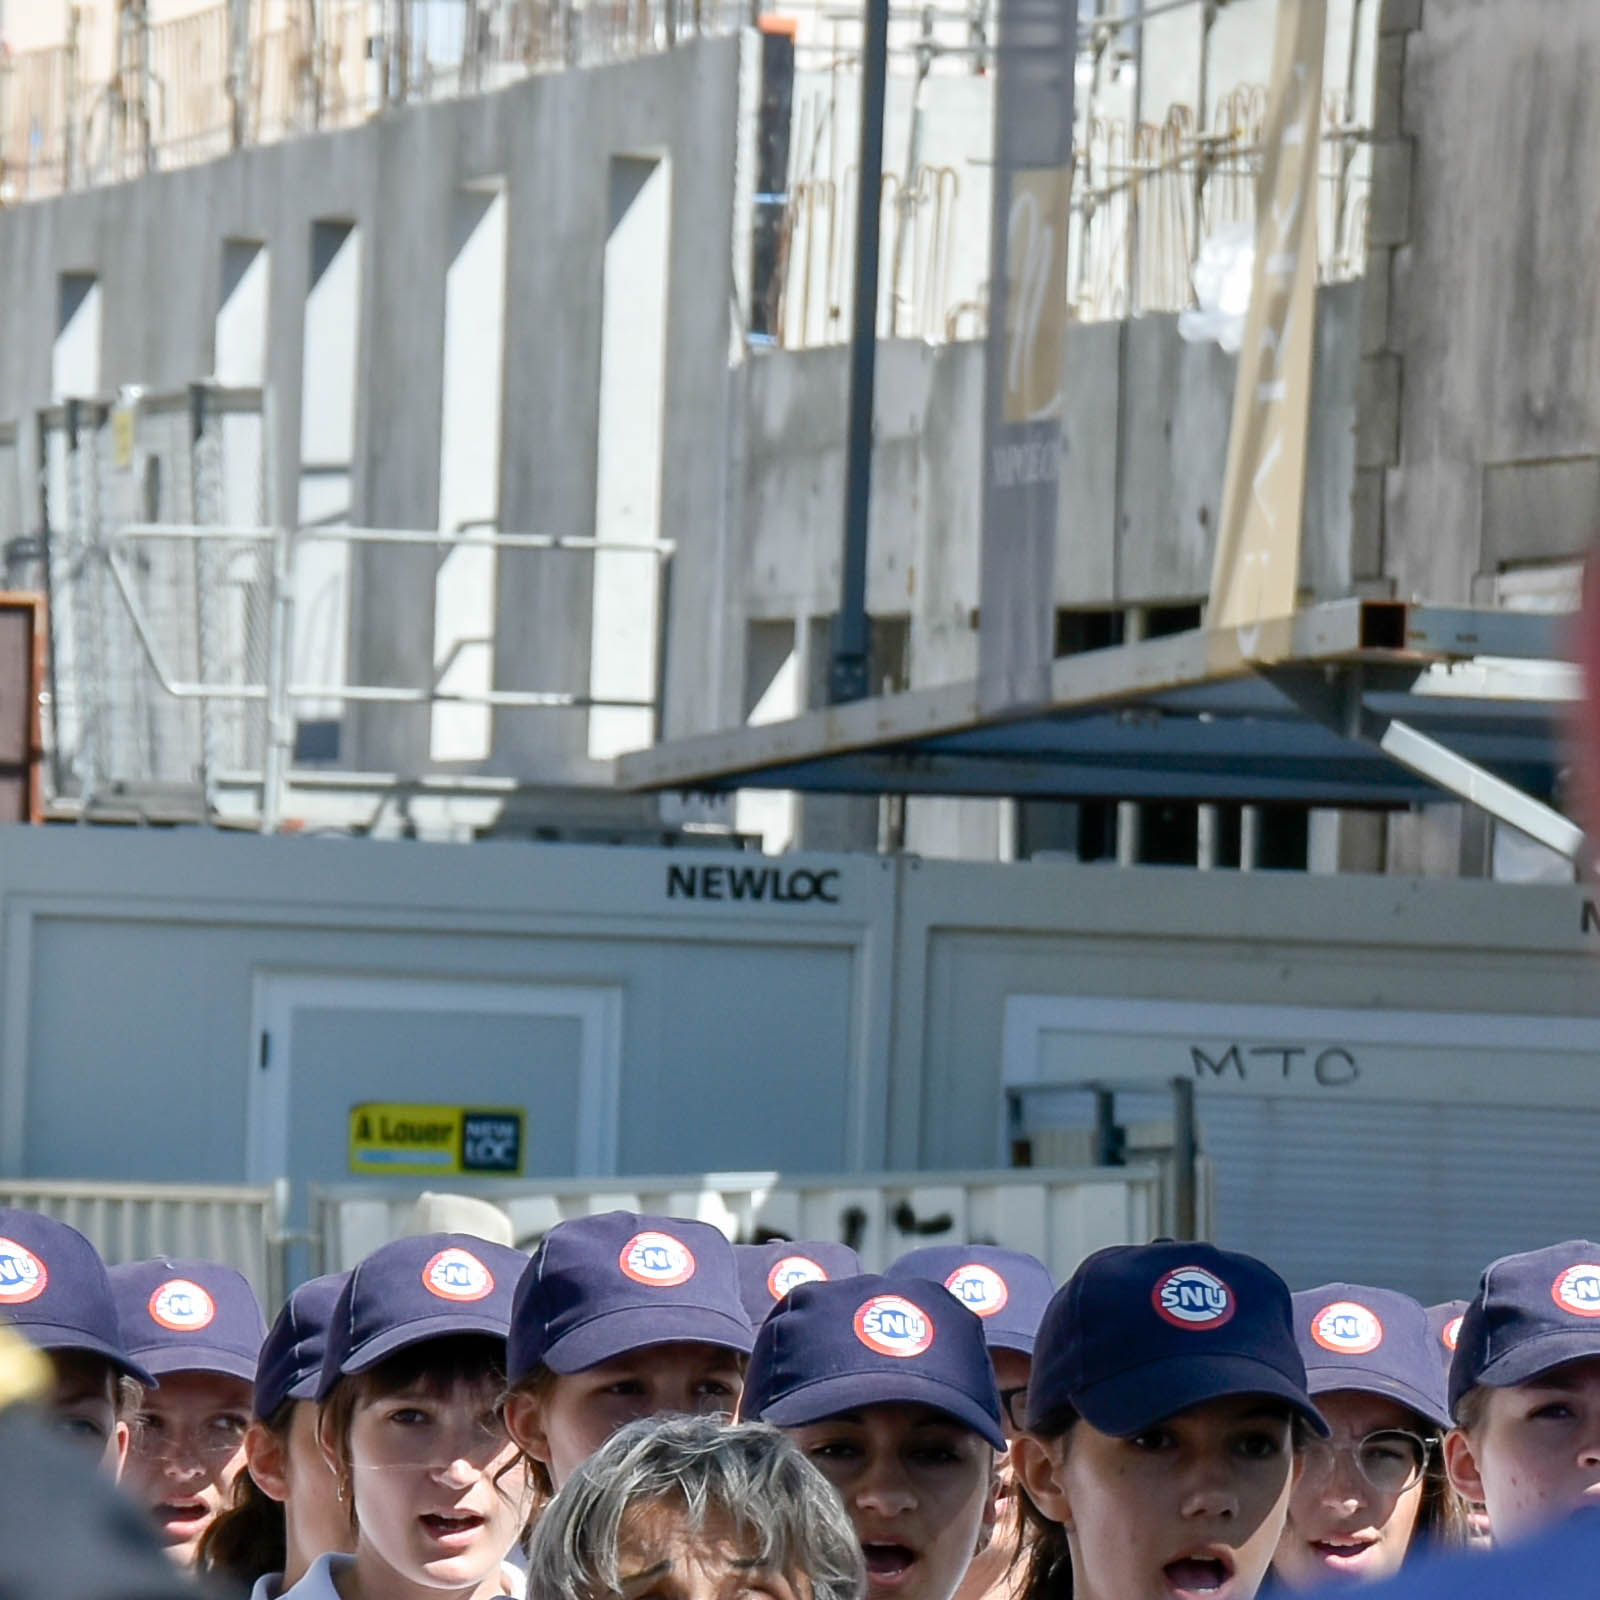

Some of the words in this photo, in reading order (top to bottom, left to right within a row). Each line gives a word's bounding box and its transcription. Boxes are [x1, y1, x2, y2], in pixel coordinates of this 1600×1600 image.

[666, 863, 841, 904] NEWLOC
[380, 1115, 453, 1144] Louer
[466, 1122, 515, 1138] NEW
[1160, 1284, 1228, 1309] SNU
[864, 1311, 926, 1339] SNU
